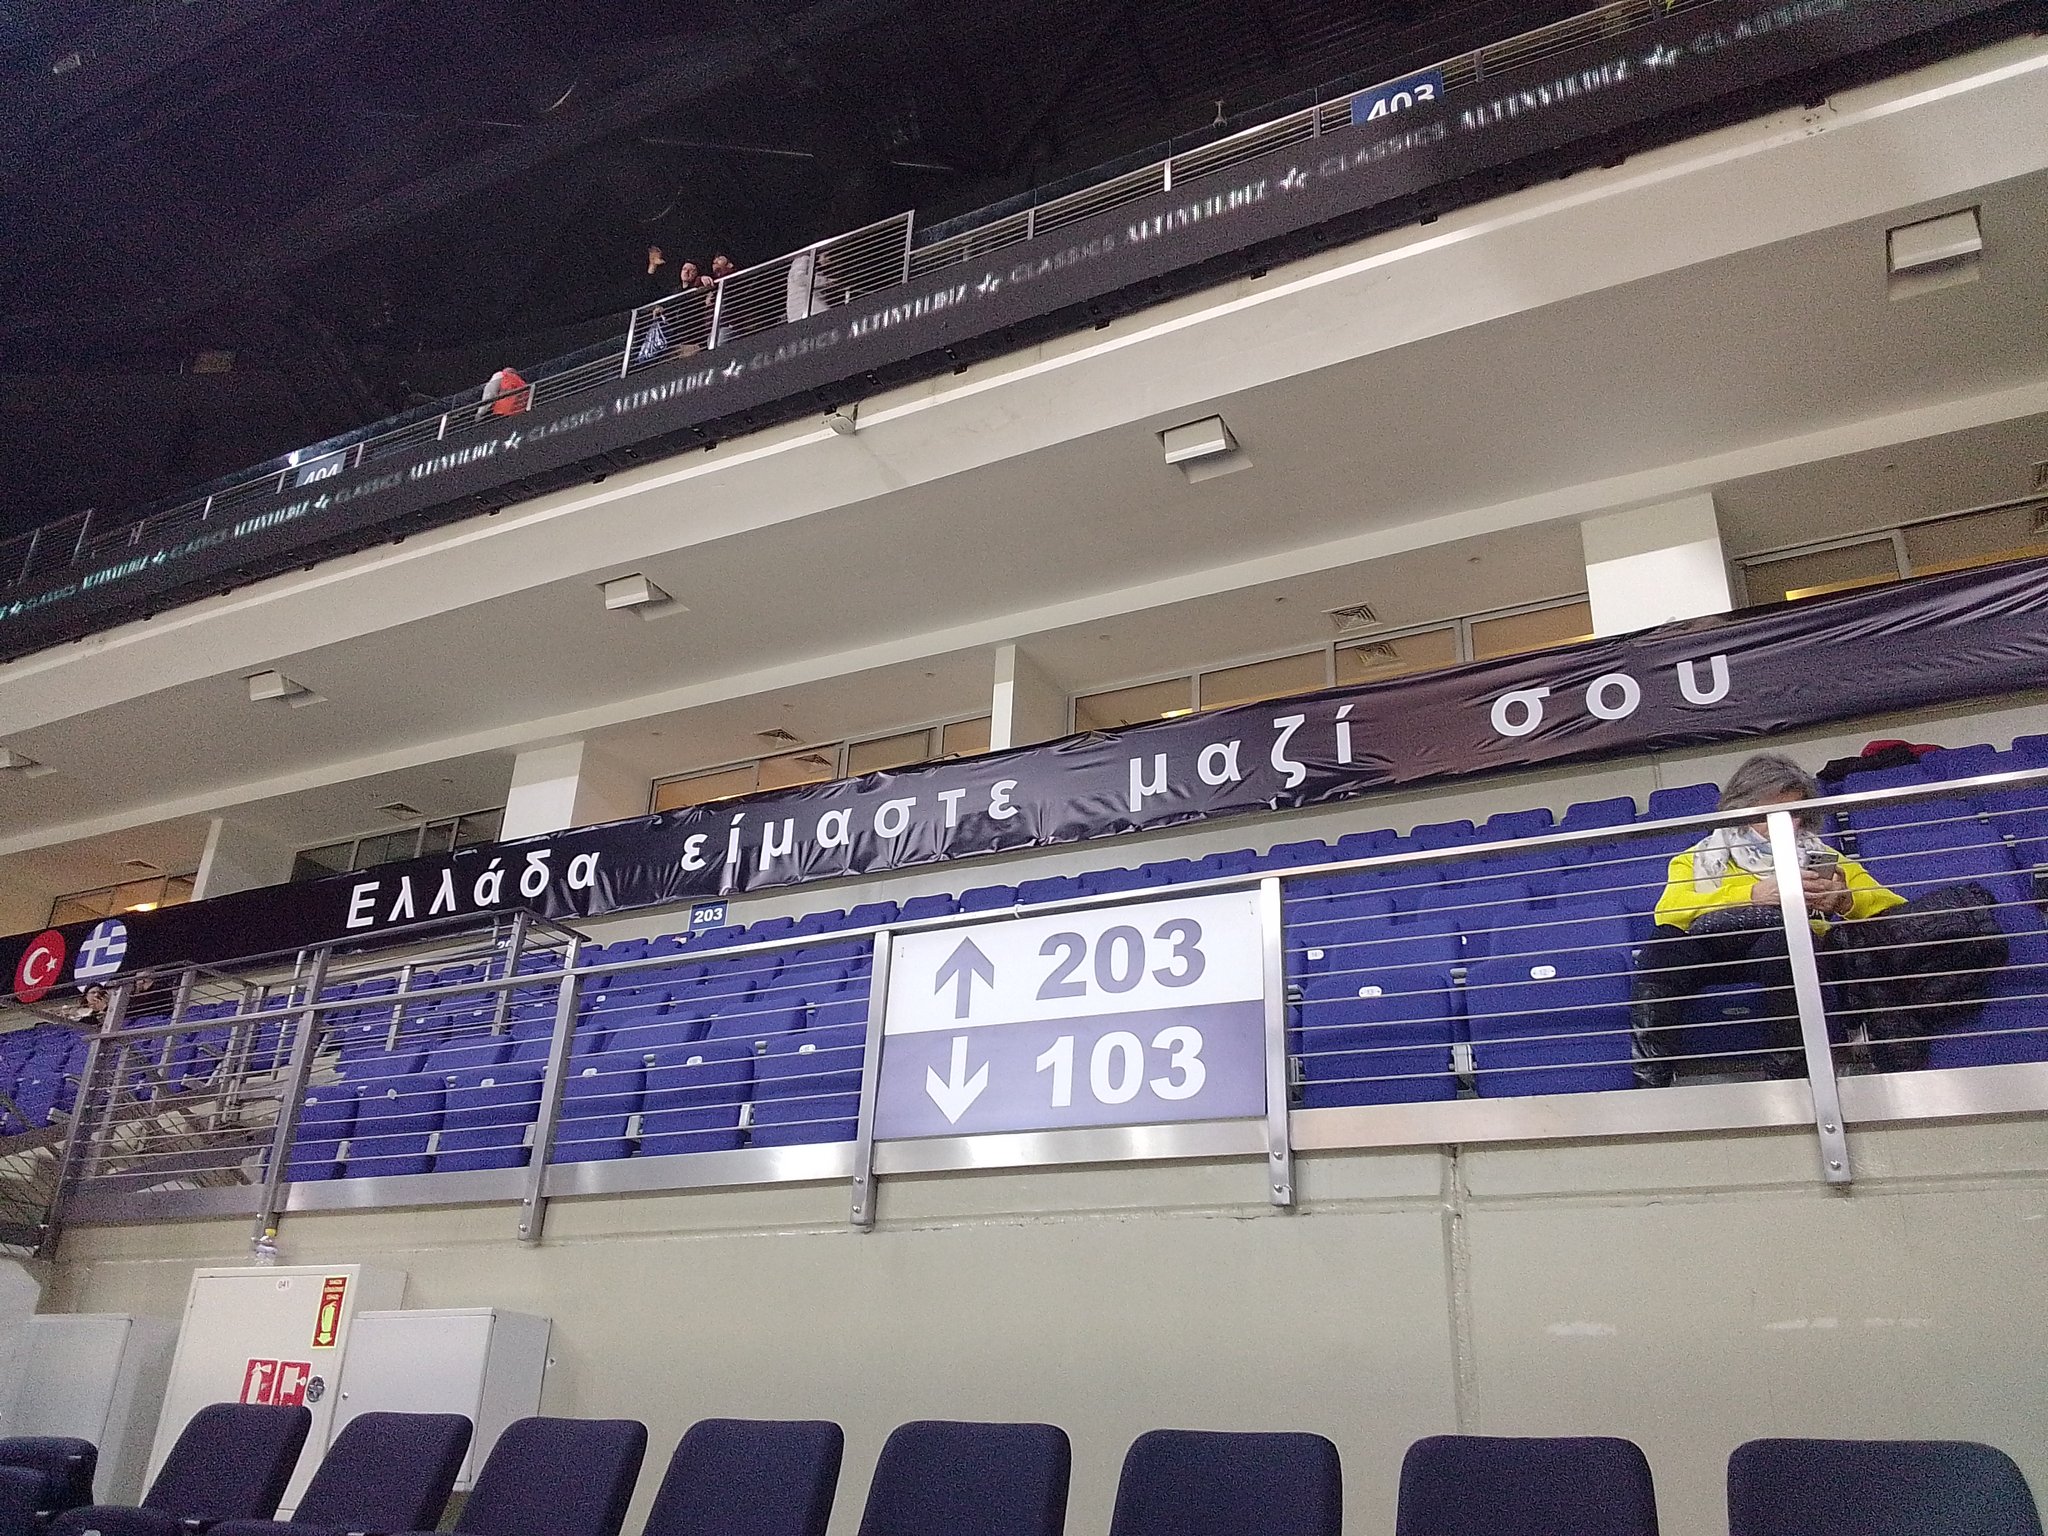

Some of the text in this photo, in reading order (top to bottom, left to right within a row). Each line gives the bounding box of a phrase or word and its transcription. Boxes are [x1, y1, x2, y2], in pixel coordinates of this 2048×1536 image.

[1365, 83, 1436, 122] 403
[346, 655, 1731, 929] Ελλάδα είμαστε μαζί σου
[693, 907, 724, 924] 203
[1036, 918, 1207, 1001] 203
[1035, 1026, 1207, 1108] 103
